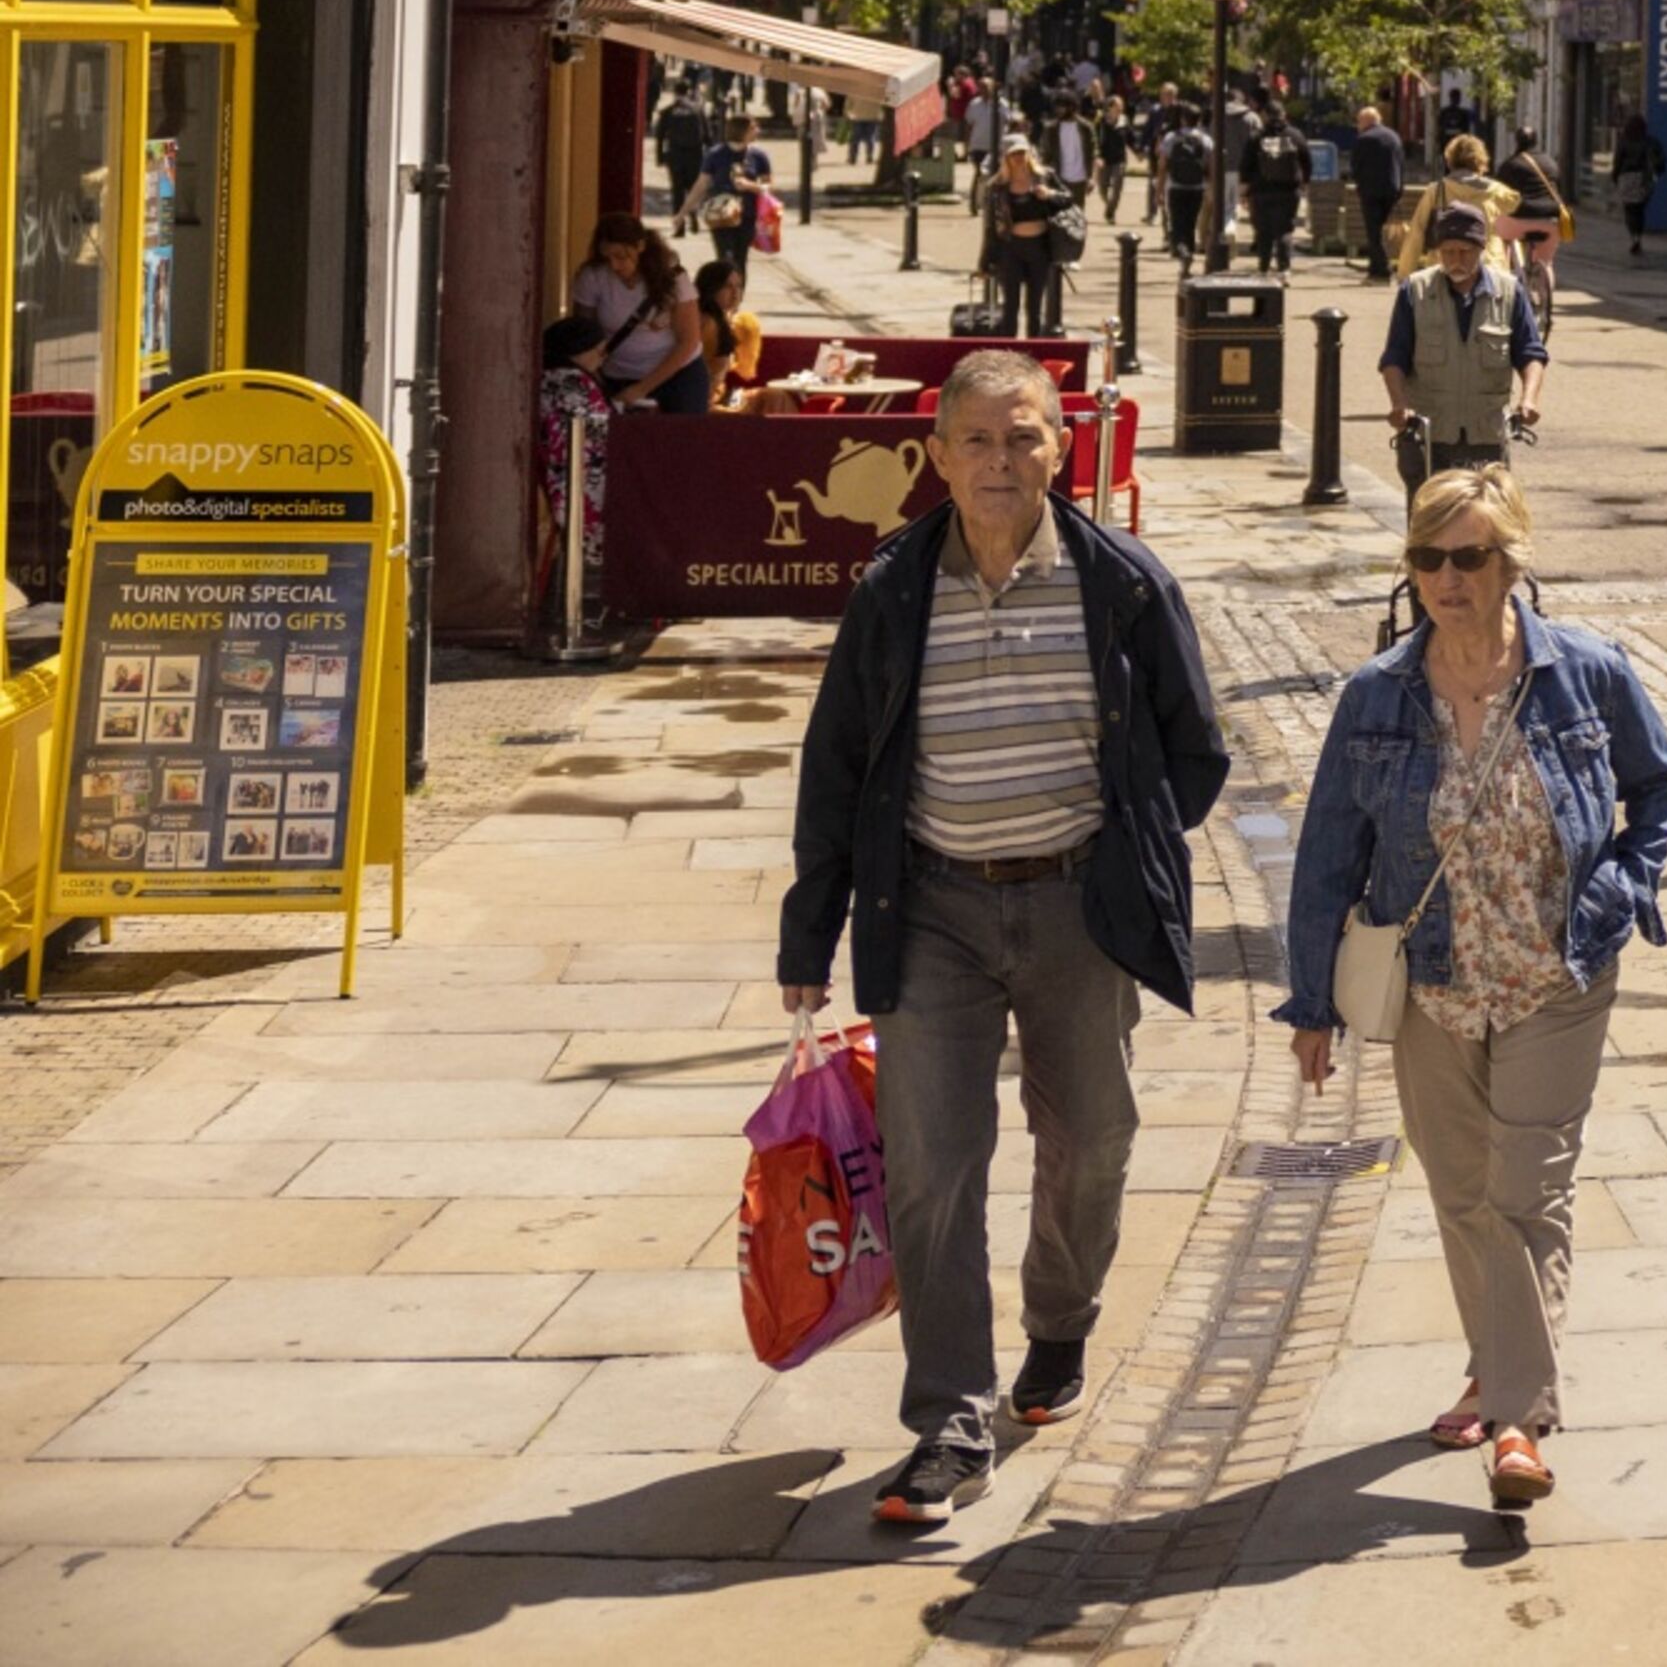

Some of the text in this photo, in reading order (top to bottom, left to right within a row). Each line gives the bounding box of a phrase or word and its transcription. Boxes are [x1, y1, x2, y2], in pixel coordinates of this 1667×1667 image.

[251, 499, 346, 519] specialists
[145, 559, 317, 570] SHARE YOUR MEMORIES
[687, 563, 839, 586] SPECIALITIES
[120, 585, 337, 603] TURN YOUR SPECIAL
[110, 612, 346, 630] MOMENTS INTO GIFTS
